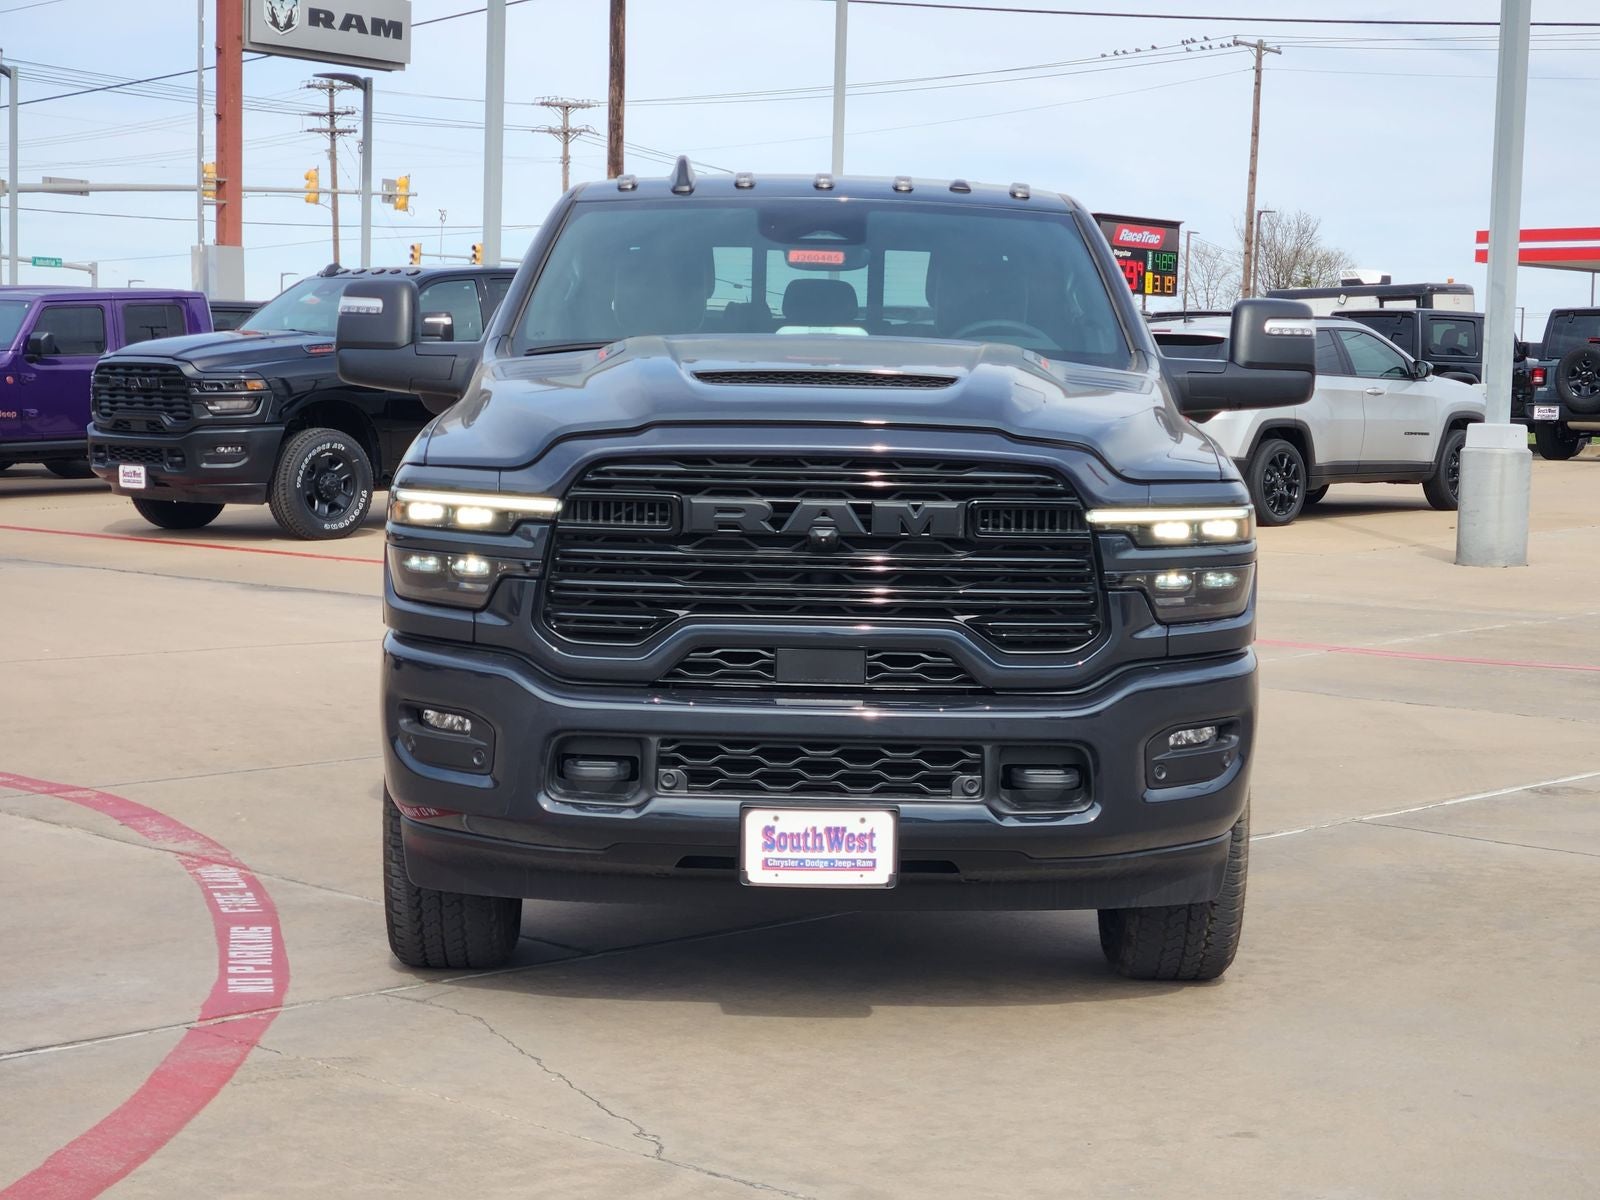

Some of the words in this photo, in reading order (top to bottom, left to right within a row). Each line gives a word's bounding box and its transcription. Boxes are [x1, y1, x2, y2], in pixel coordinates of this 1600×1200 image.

[308, 7, 403, 41] RAM
[1119, 228, 1160, 244] RaceTrac
[0, 411, 17, 419] eep
[690, 497, 963, 535] RAM
[762, 824, 877, 853] SouthWest
[767, 858, 799, 868] Chrysler
[805, 859, 829, 868] Dodge
[834, 859, 852, 868] Jeep
[227, 926, 273, 973] PARKING
[227, 977, 274, 993] NO
